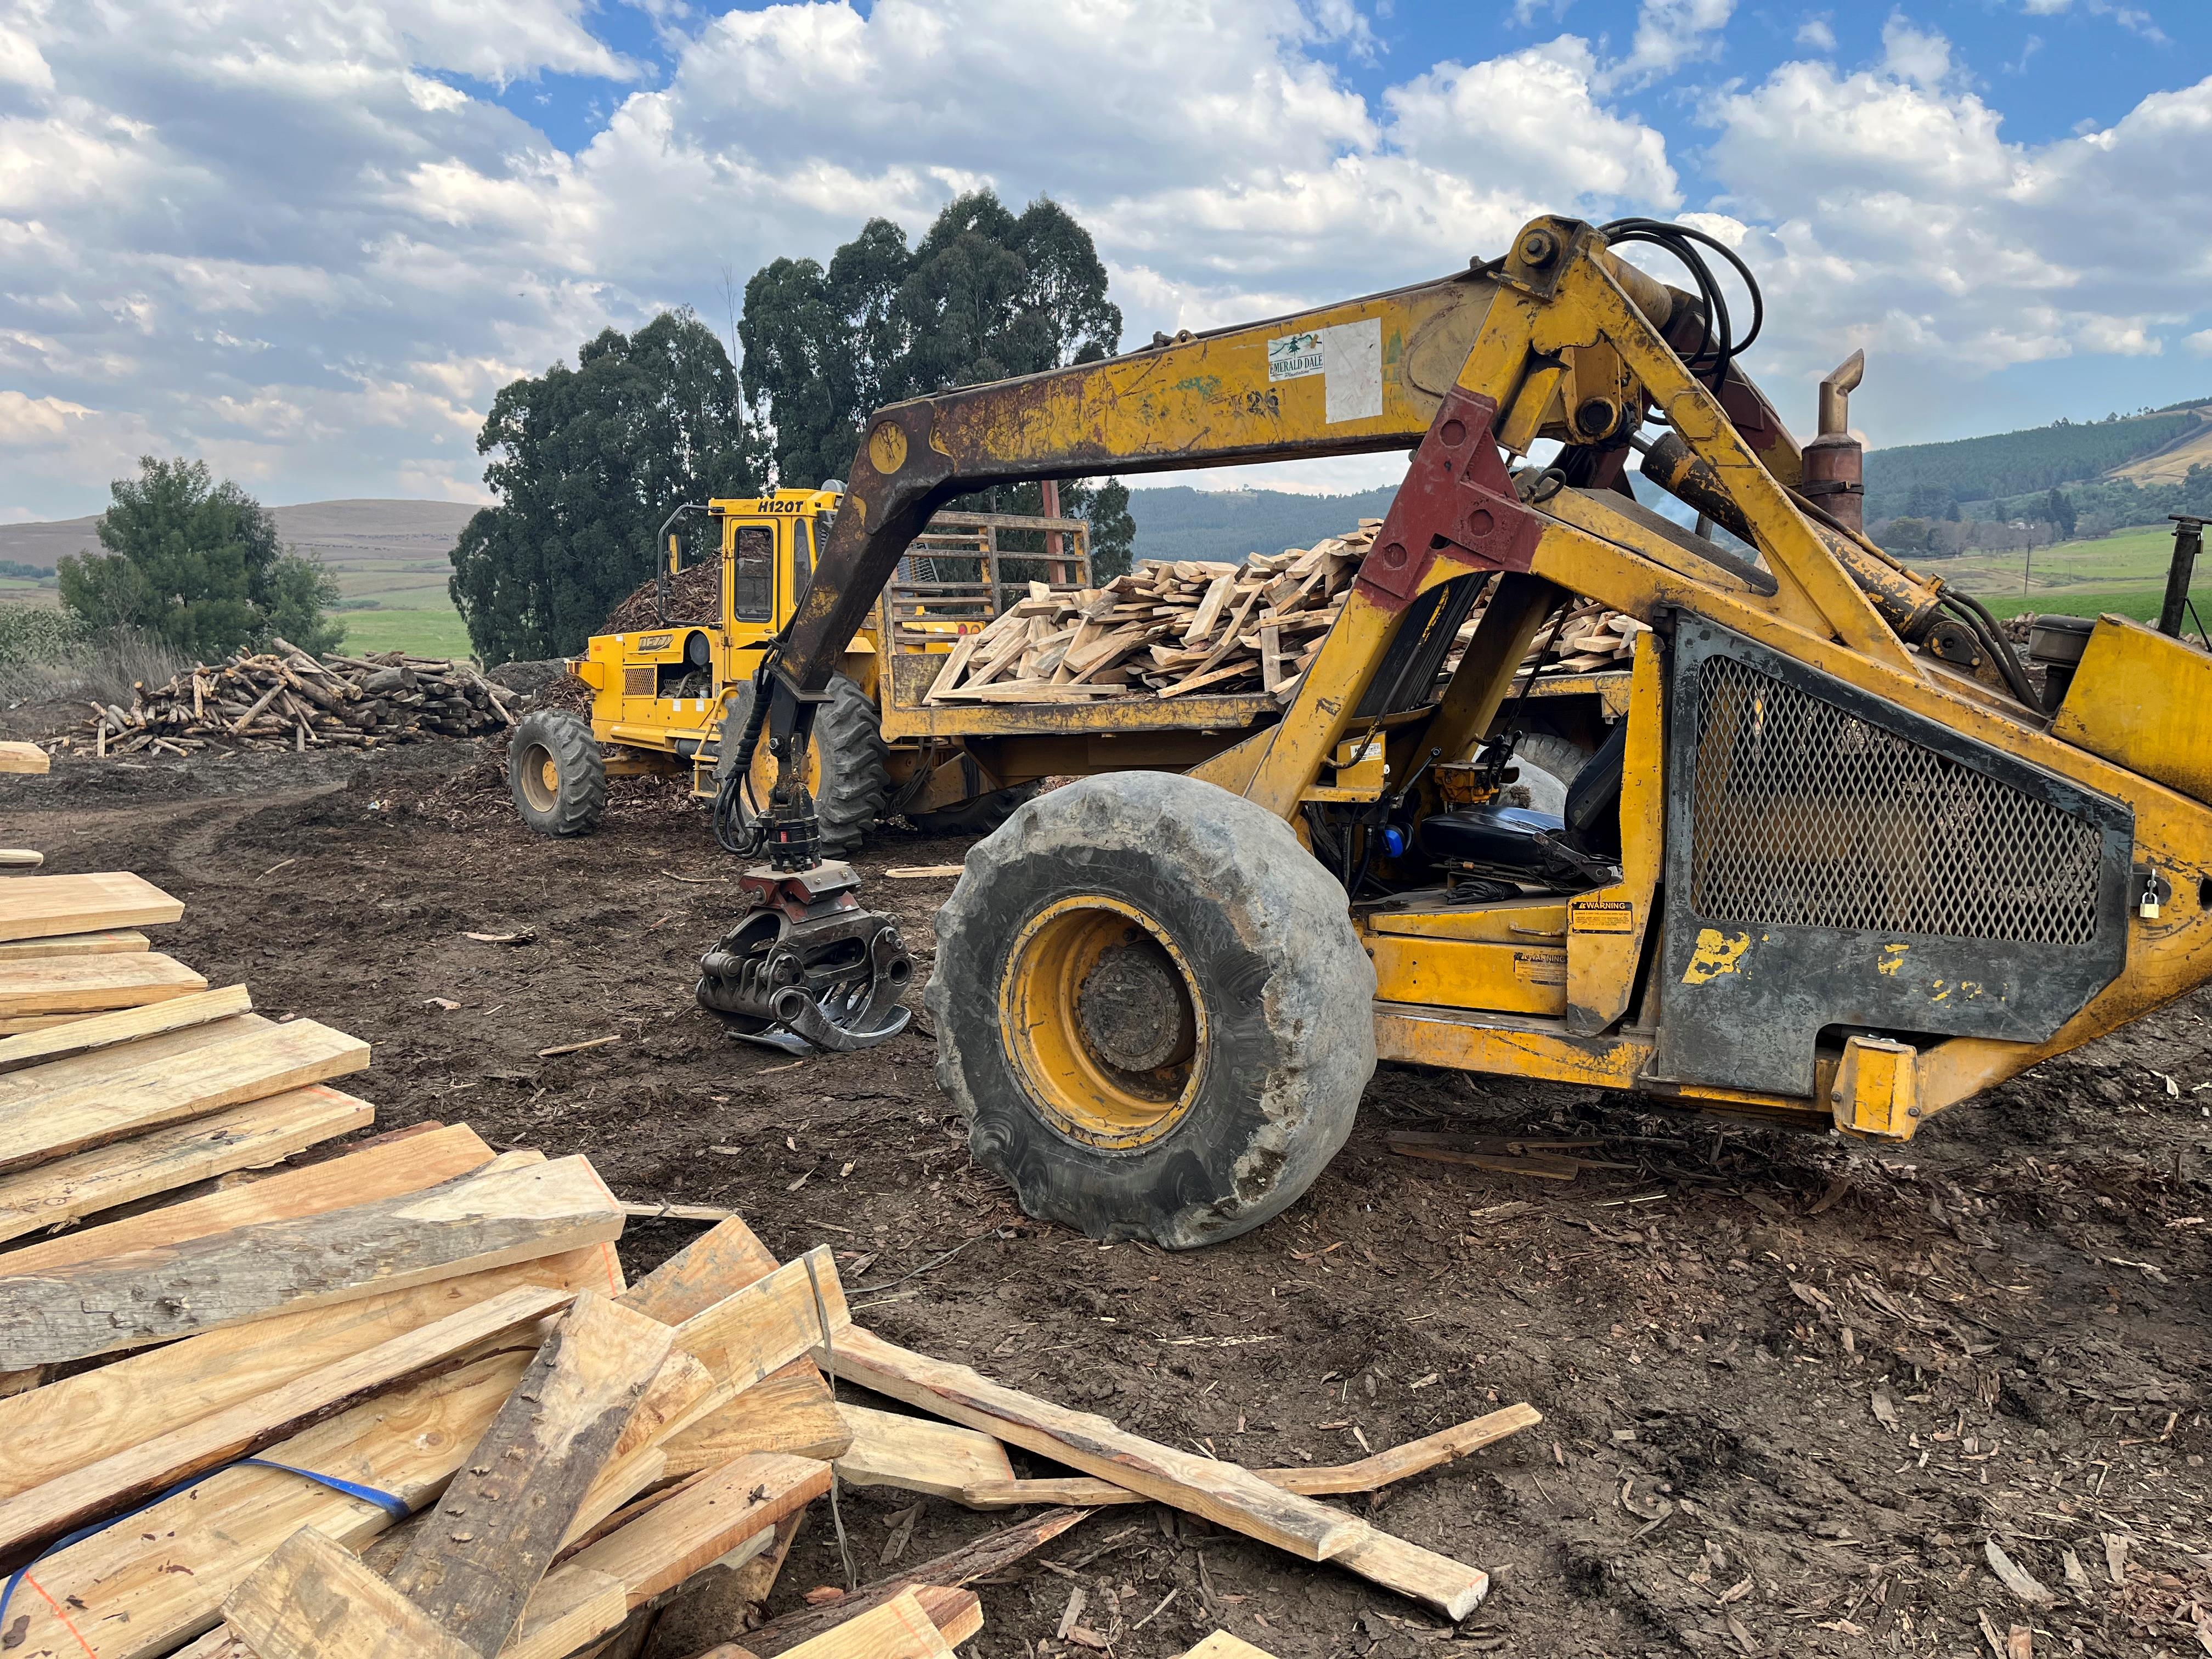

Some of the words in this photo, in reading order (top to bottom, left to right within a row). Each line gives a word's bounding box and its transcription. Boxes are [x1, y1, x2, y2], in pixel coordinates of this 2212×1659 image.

[1270, 358, 1302, 374] EMERALD
[1305, 355, 1323, 368] DALE
[1284, 369, 1310, 377] Plantation
[758, 500, 804, 512] H120T
